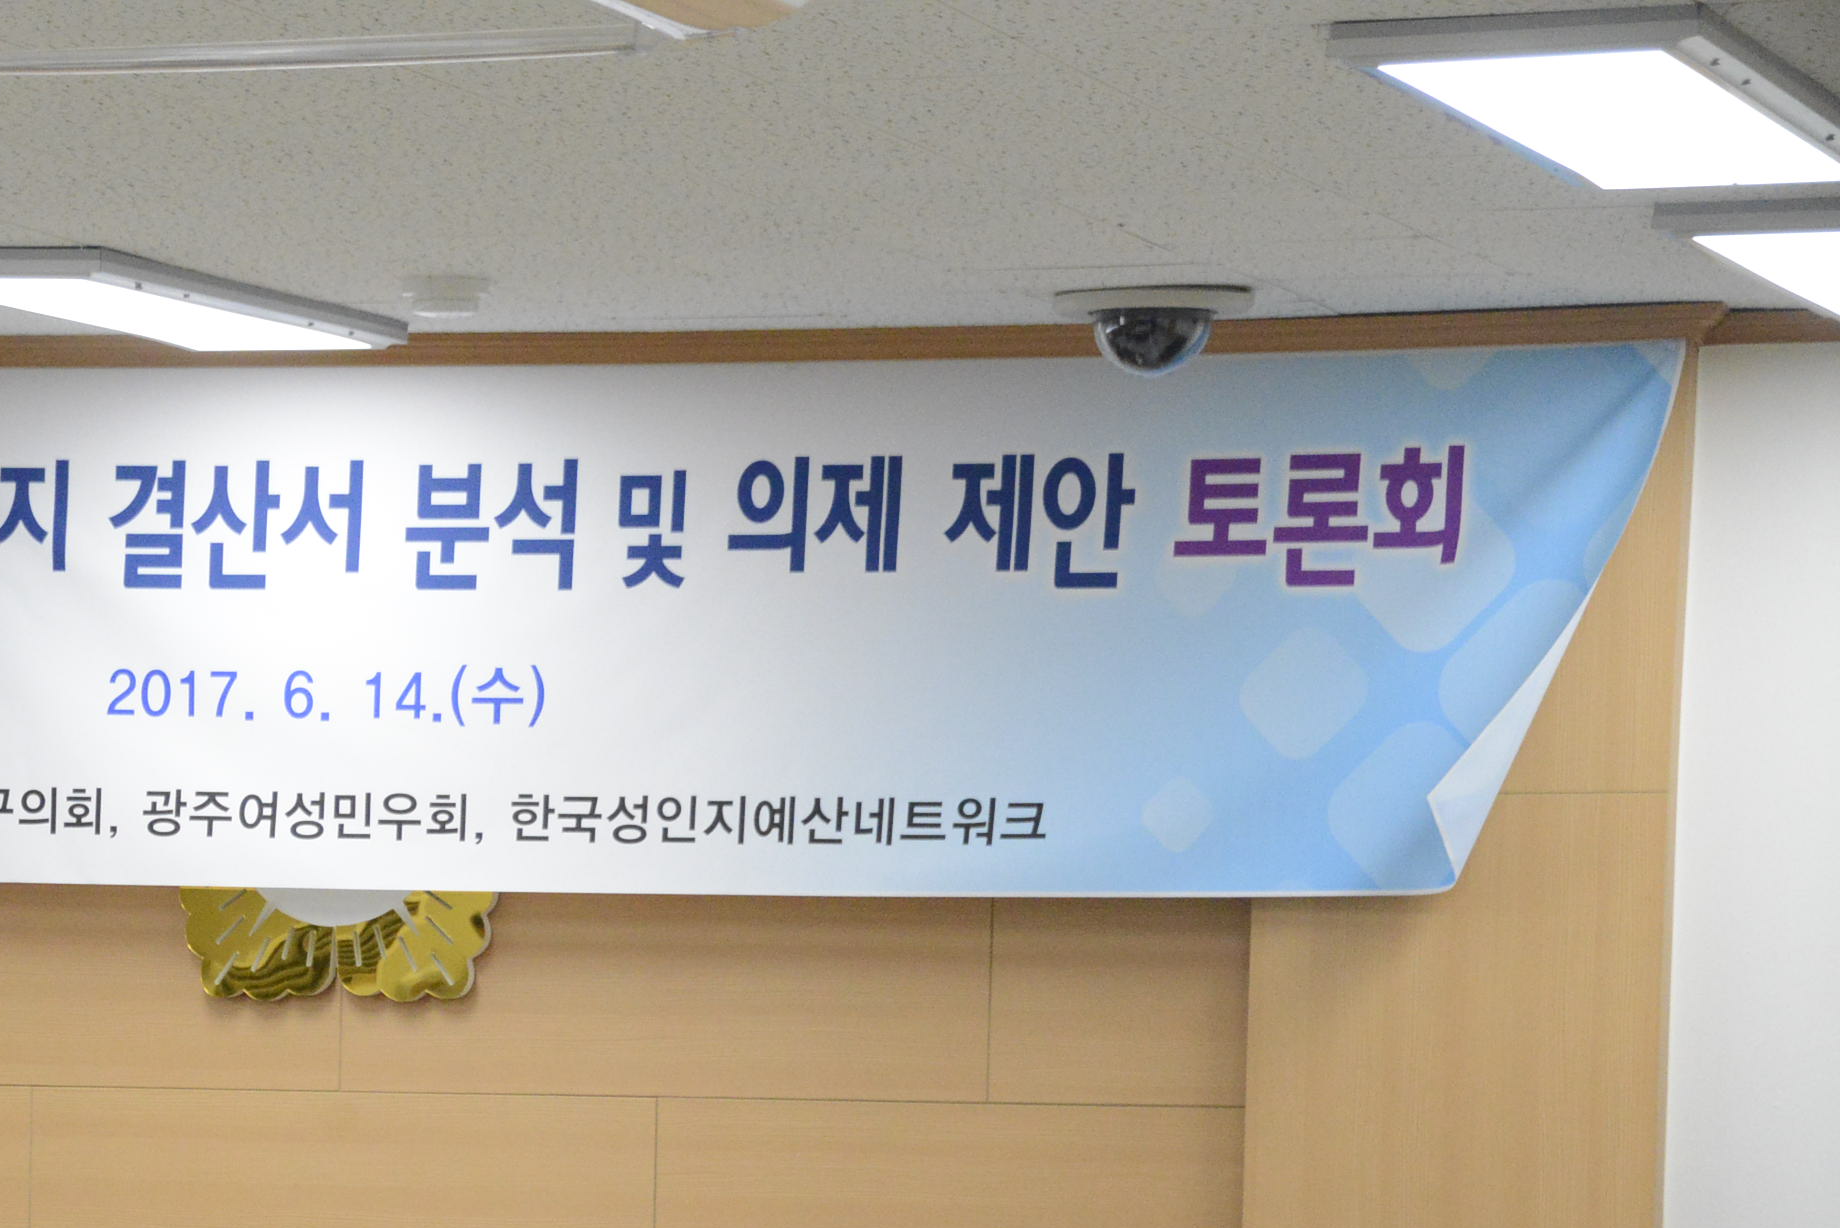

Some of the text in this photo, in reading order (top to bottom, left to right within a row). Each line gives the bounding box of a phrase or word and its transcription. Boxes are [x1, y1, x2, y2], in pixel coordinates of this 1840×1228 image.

[107, 458, 365, 590] 결산서
[404, 455, 581, 591] 분석
[618, 468, 688, 589] 및
[727, 454, 904, 573] 의제
[943, 451, 1137, 590] 제안
[1173, 444, 1466, 587] 토론회
[106, 663, 546, 729] 2017. 6. 14.(수)
[141, 788, 484, 846] 광주여성민우회,
[510, 790, 1048, 847] 한국성인지예산네트워크
